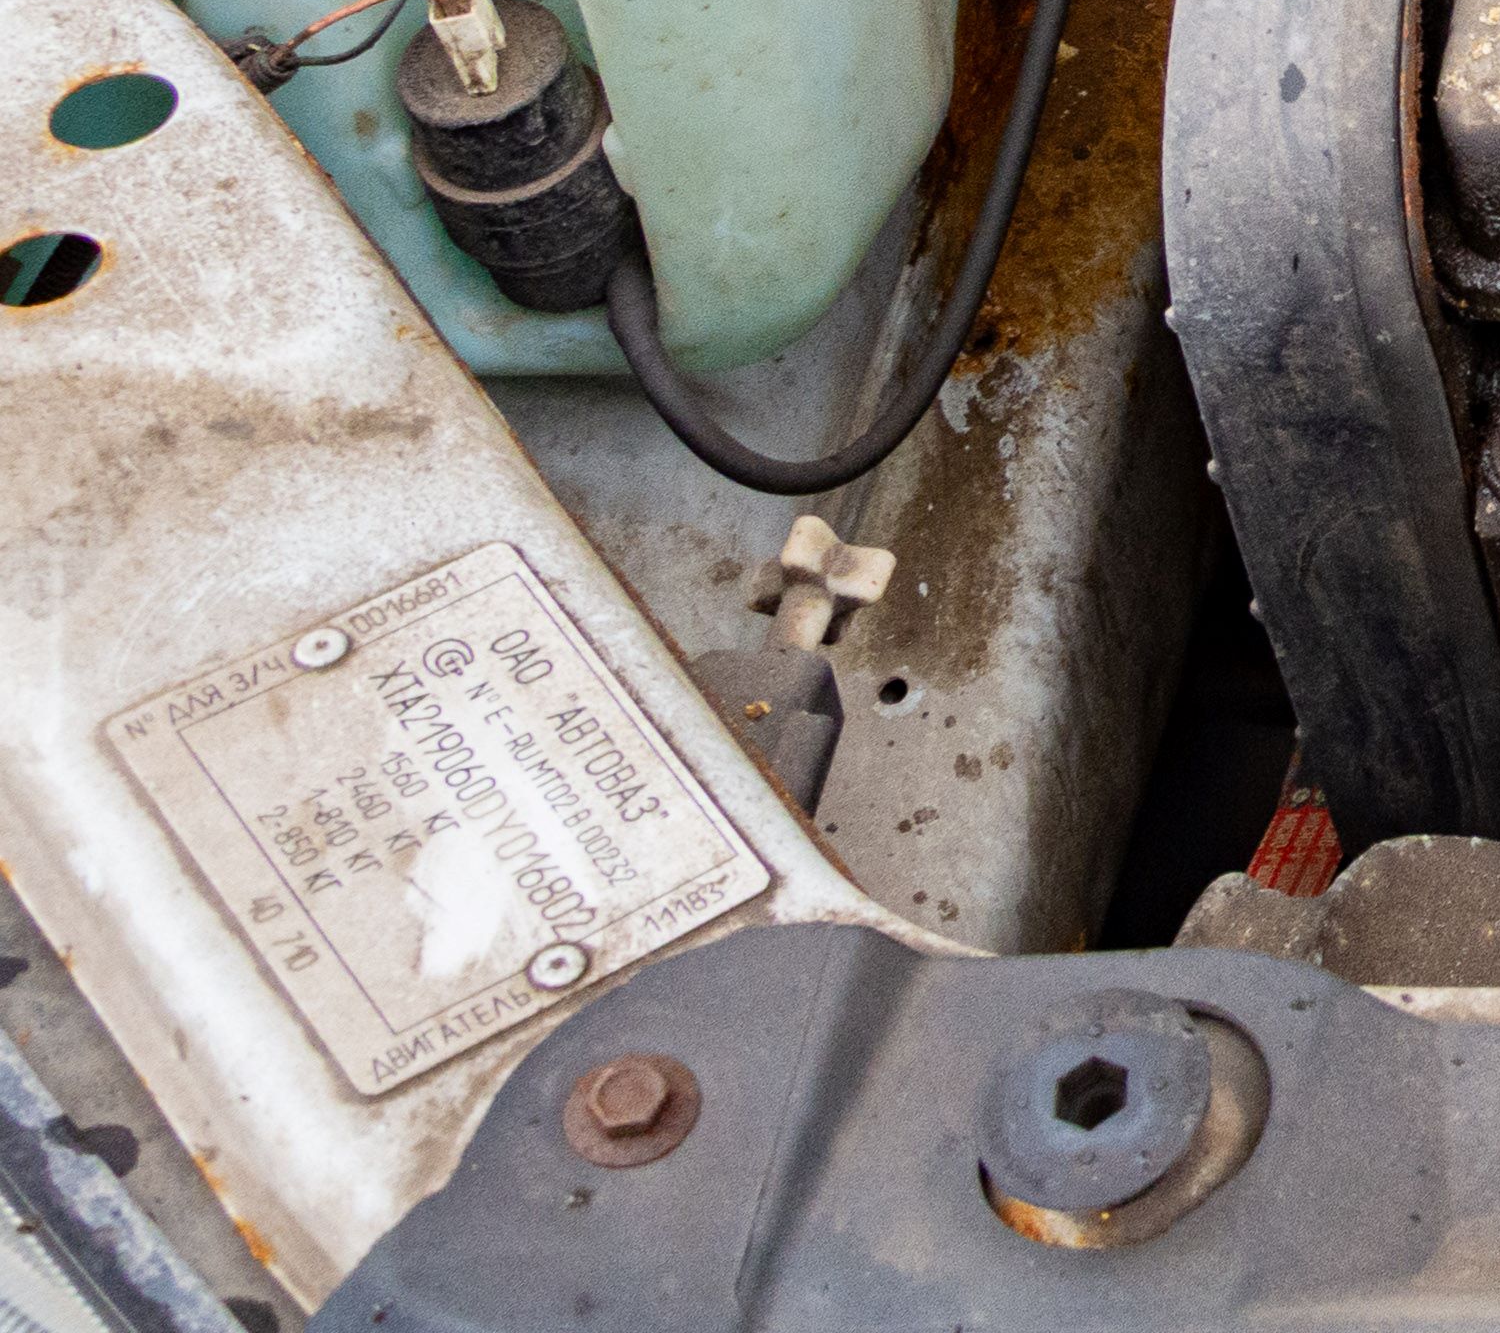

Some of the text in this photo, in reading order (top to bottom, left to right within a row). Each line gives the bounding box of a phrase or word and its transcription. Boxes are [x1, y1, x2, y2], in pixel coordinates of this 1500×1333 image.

[160, 682, 229, 728] ДЛЯ
[345, 568, 467, 637] 0016681
[374, 746, 462, 841] 1560 КГ
[484, 624, 671, 835] ОАО "АВТОВАЗ"
[254, 801, 345, 901] 2-850 КГ
[294, 783, 384, 881] 1-810 КГ
[333, 763, 423, 860] 2460 КГ
[360, 658, 601, 942] XTA219060DY016802
[362, 879, 727, 1087] ДВИГАТЕЛЬ 11183
